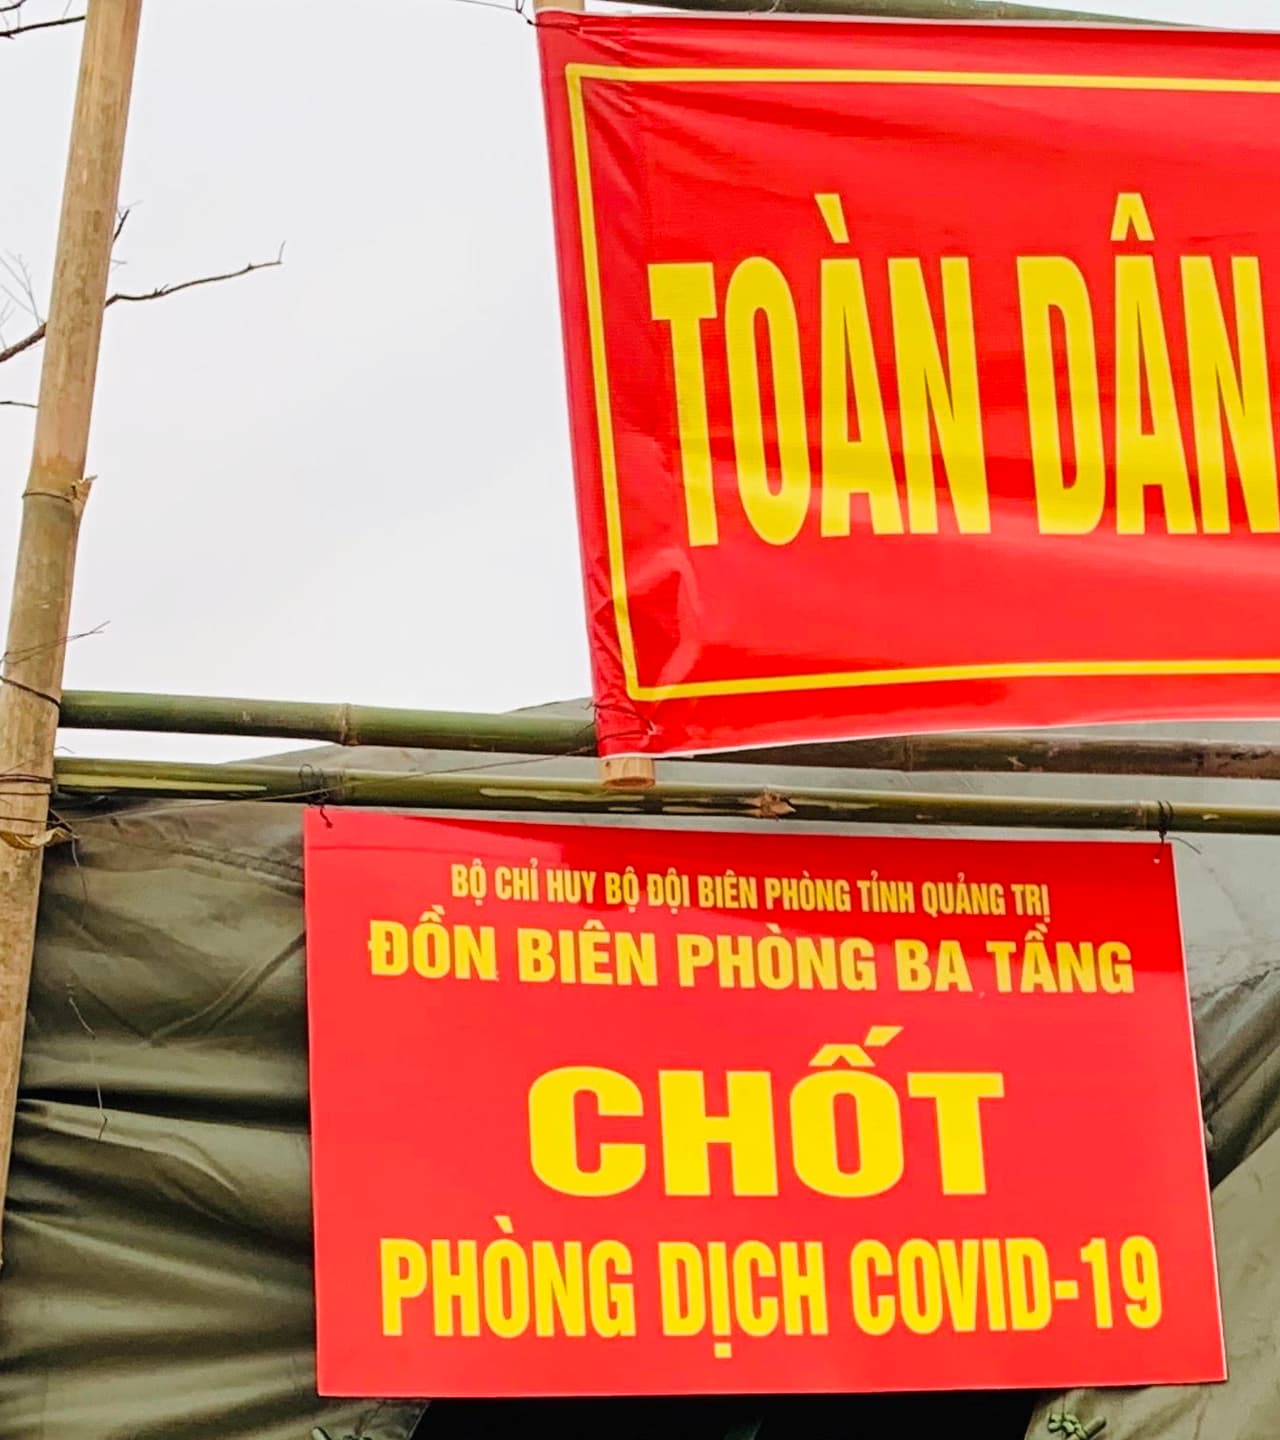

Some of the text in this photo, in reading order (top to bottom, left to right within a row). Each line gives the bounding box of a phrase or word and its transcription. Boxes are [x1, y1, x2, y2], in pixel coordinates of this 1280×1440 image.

[648, 193, 991, 546] TOÀN
[1016, 192, 1280, 535] DÂN
[368, 905, 1134, 994] ĐỒN BIÊN PHÒNG BA TẦNG
[451, 857, 1051, 923] BỘ CHỈ HUY BỘ ĐỘI BIÊN PHÒNG TỈNH QUẢNG TRỊ
[528, 1025, 1005, 1198] CHỐT
[380, 1216, 1163, 1359] PHÒNG DỊCH COVID-19
